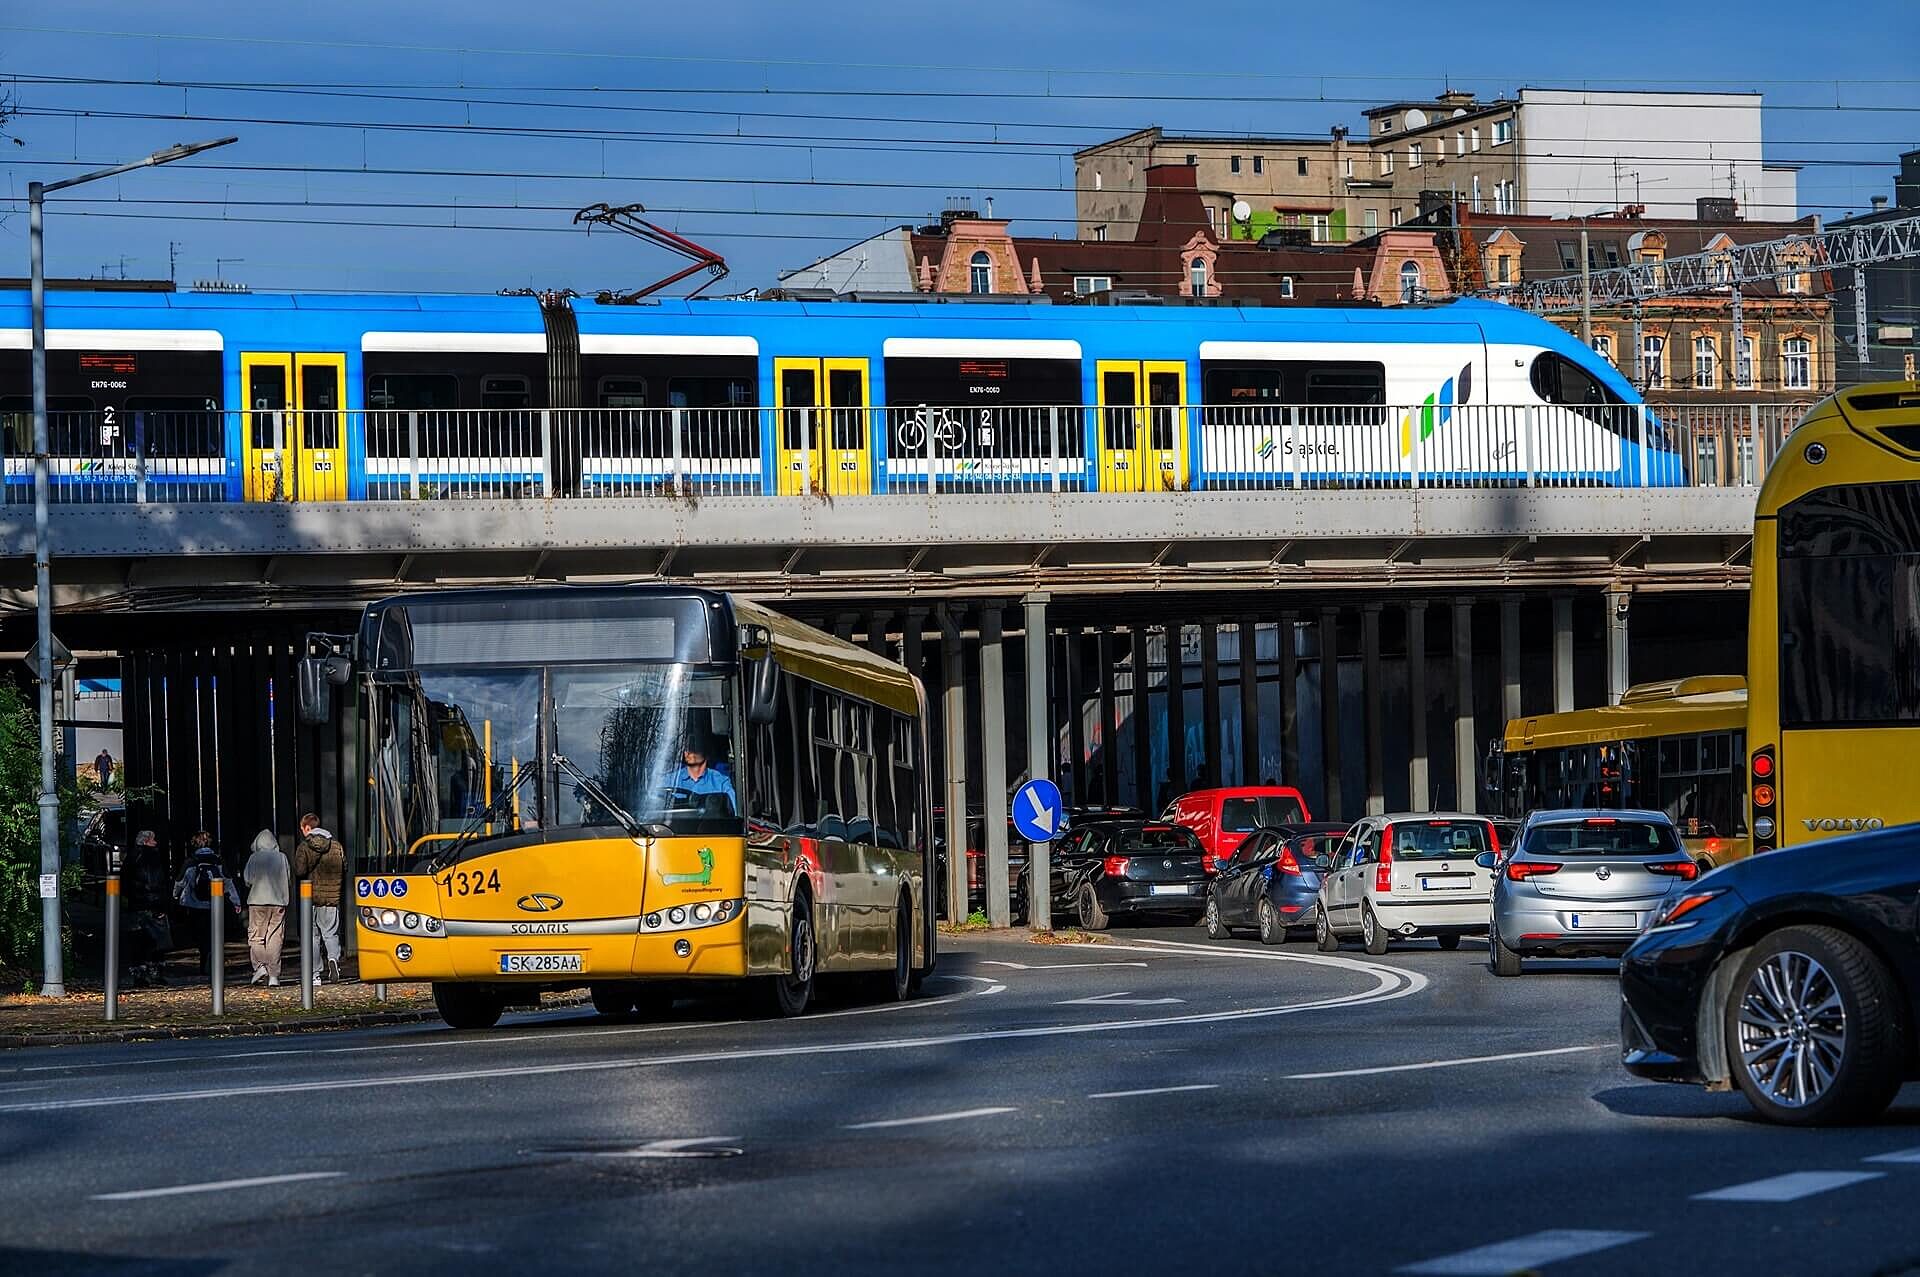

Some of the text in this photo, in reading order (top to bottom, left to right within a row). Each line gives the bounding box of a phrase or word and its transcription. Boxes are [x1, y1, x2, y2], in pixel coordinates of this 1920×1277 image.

[1284, 437, 1340, 459] Śąskie.
[1801, 818, 1884, 832] VOLVO
[443, 868, 501, 898] 1324
[511, 923, 569, 934] SOLARIS
[510, 956, 579, 971] SK 285AA
